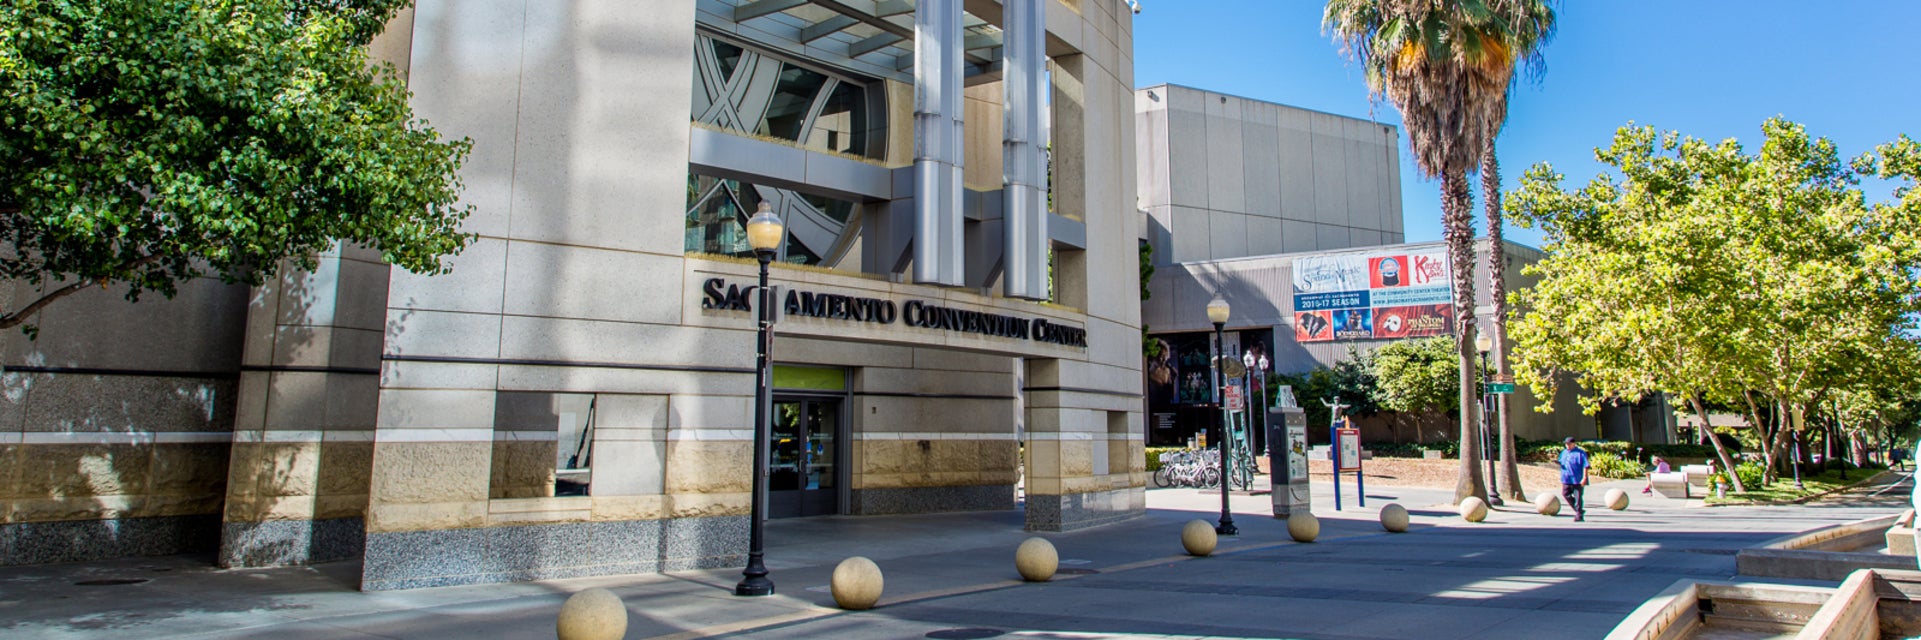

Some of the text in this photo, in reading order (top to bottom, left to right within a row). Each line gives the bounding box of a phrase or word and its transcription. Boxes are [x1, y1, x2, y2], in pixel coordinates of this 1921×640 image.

[702, 277, 1088, 348] SACAMENTO CONVENTION CENTER
[1331, 297, 1360, 307] SEASON
